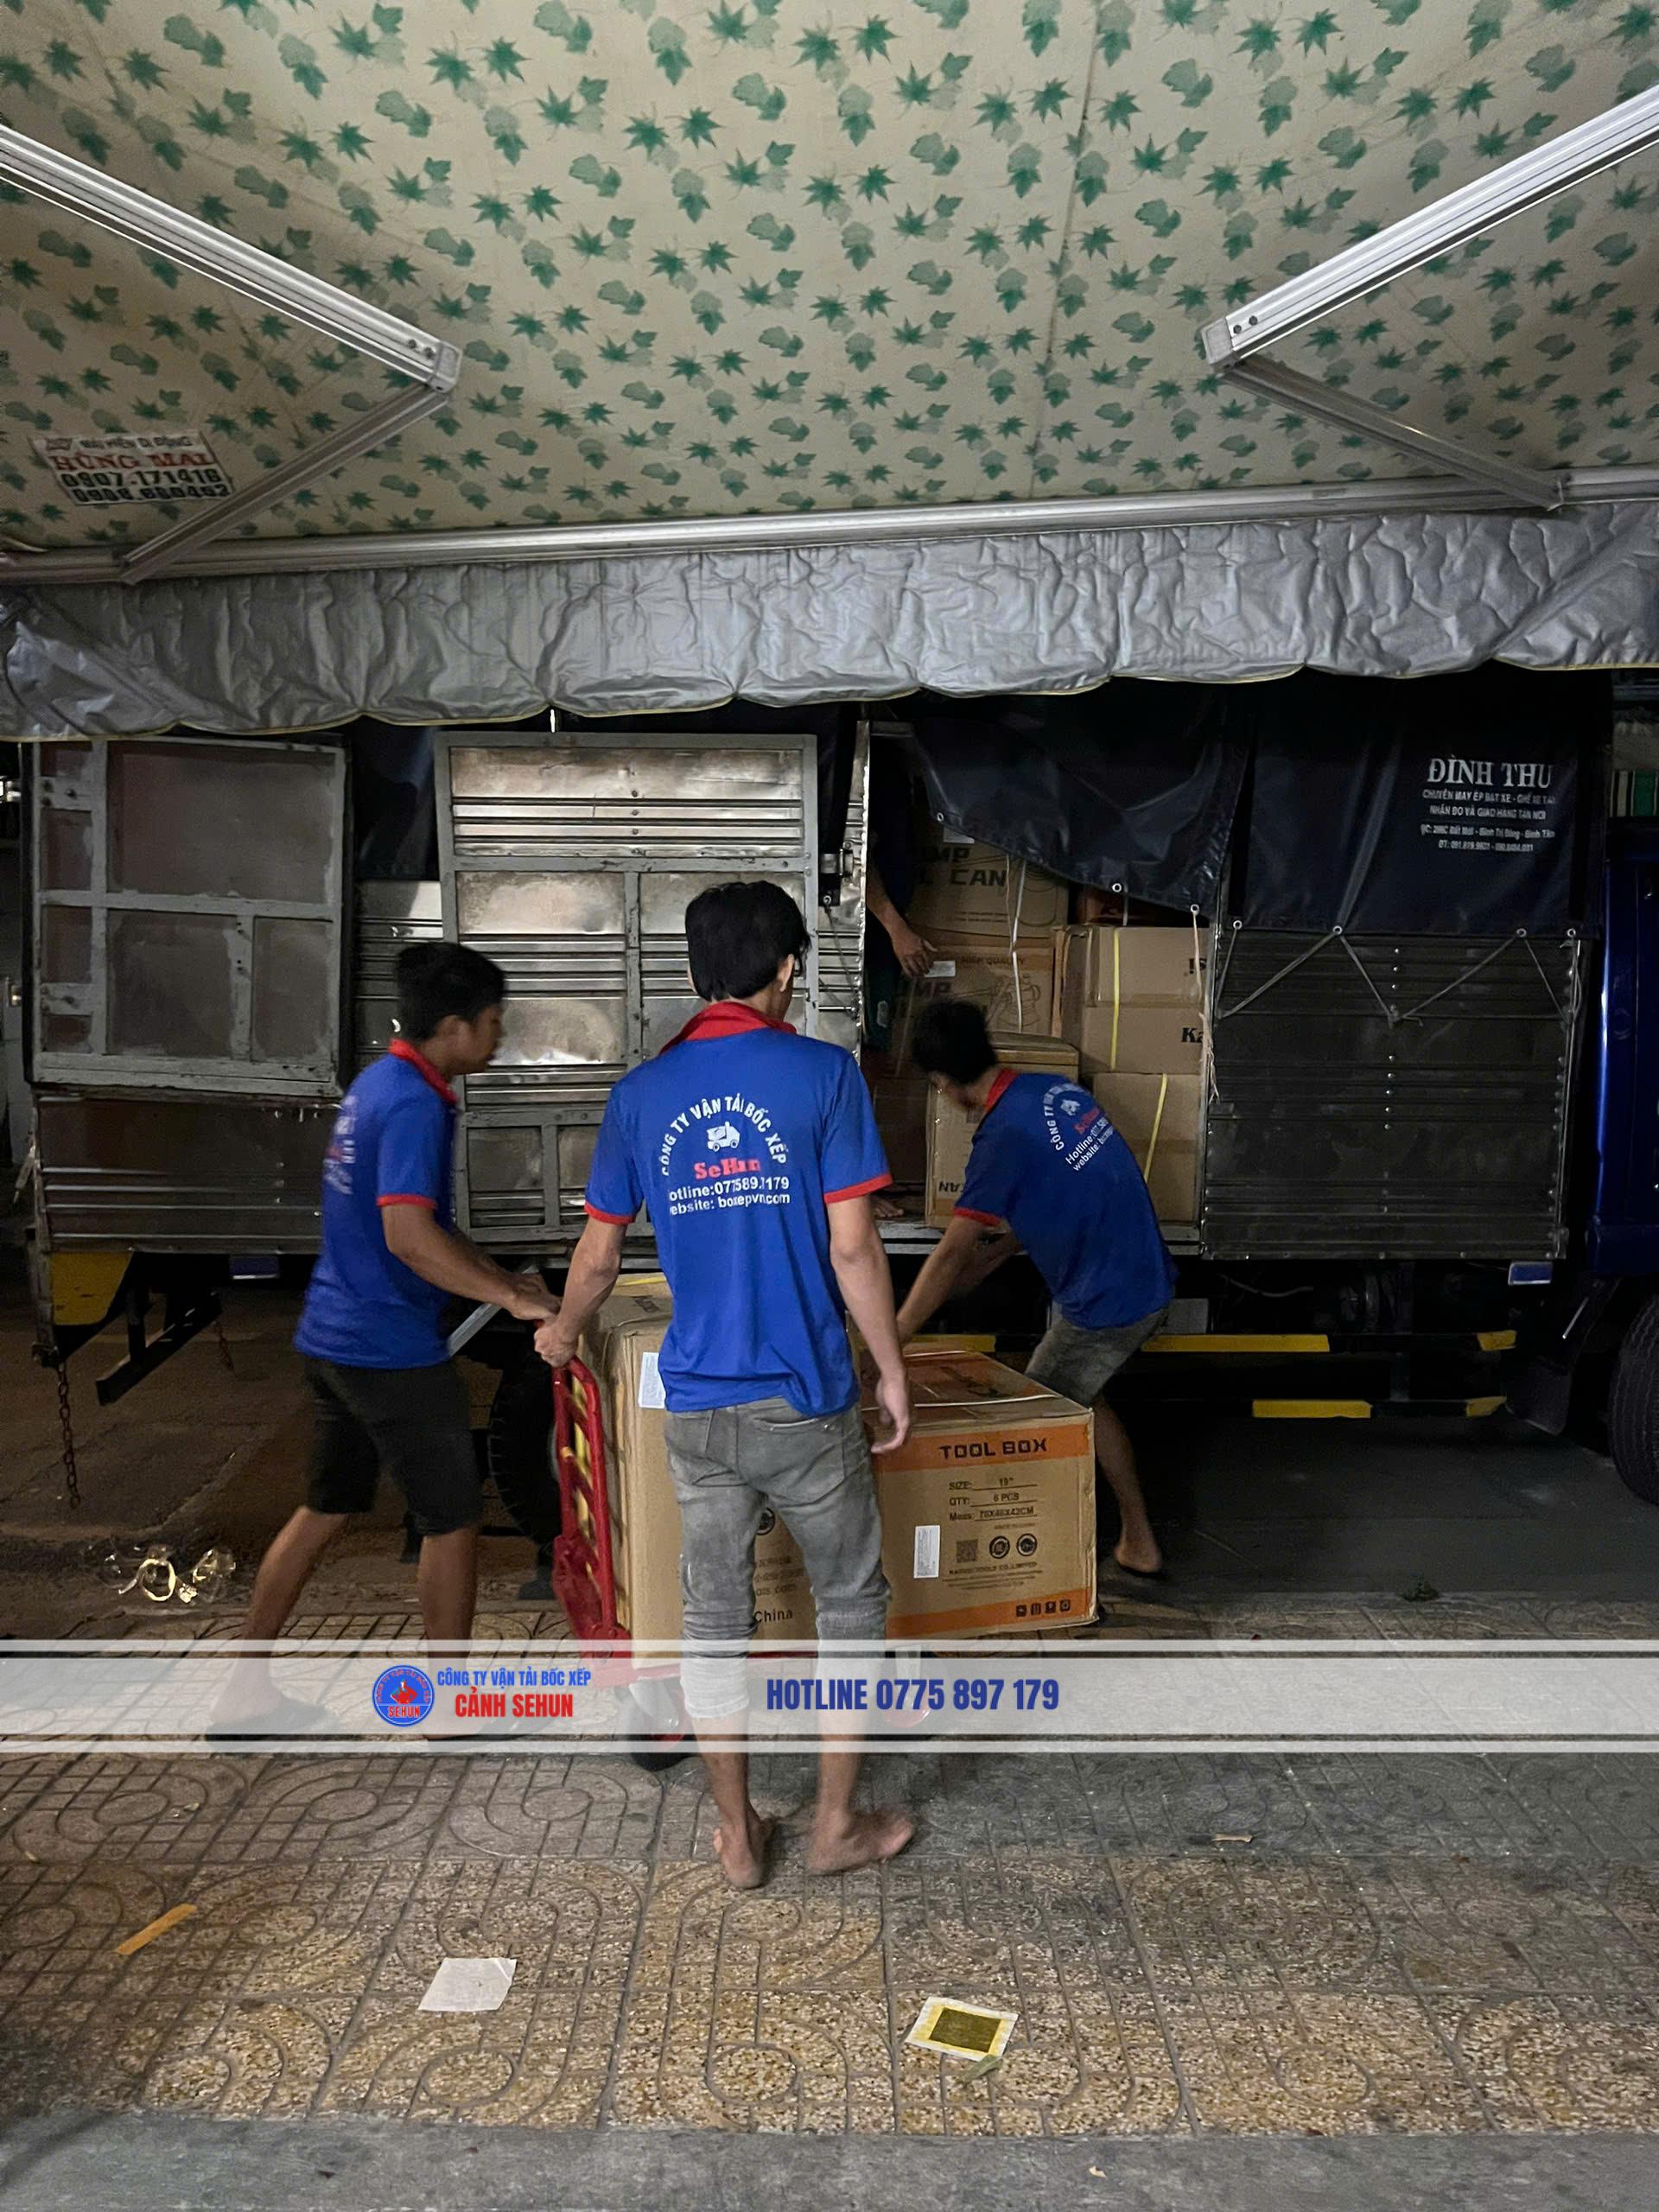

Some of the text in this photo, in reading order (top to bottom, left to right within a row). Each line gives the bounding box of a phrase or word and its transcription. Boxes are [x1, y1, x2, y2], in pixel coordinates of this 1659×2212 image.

[146, 453, 216, 467] MAI
[1427, 754, 1494, 786] ĐÌNH
[670, 1112, 690, 1134] TY
[690, 1097, 721, 1120] VẬN
[765, 1132, 789, 1165] XẾP
[669, 1199, 715, 1217] ebsite:
[939, 1437, 1048, 1460] TOOL BOX
[1001, 1491, 1020, 1502] PCS
[754, 1609, 793, 1622] China
